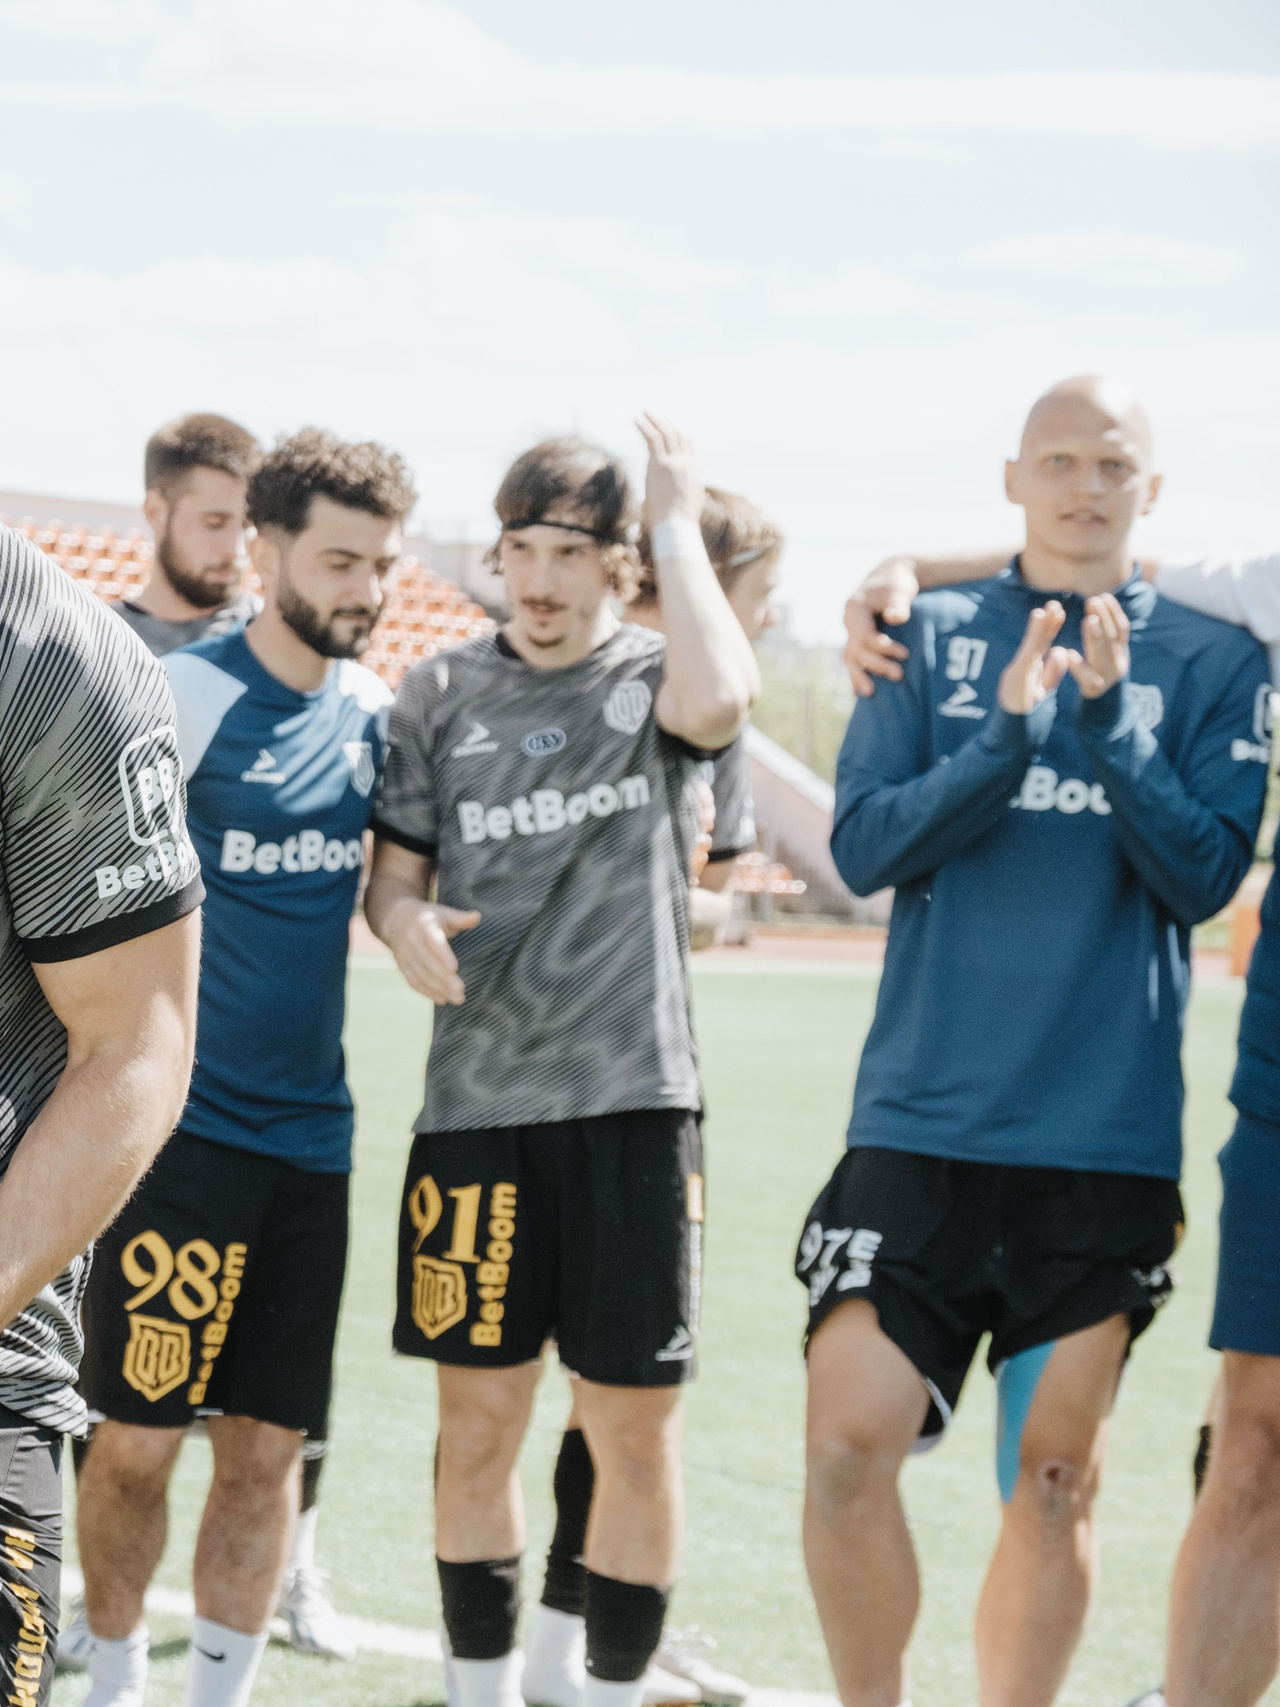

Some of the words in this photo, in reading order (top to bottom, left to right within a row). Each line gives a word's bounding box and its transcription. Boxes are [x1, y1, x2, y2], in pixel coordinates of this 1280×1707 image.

[457, 774, 650, 844] BetBoom
[95, 839, 193, 899] BetBo
[220, 828, 365, 874] BetBoo
[408, 1173, 482, 1263] 91
[120, 1229, 220, 1320] 98
[470, 1182, 517, 1347] BetBoom
